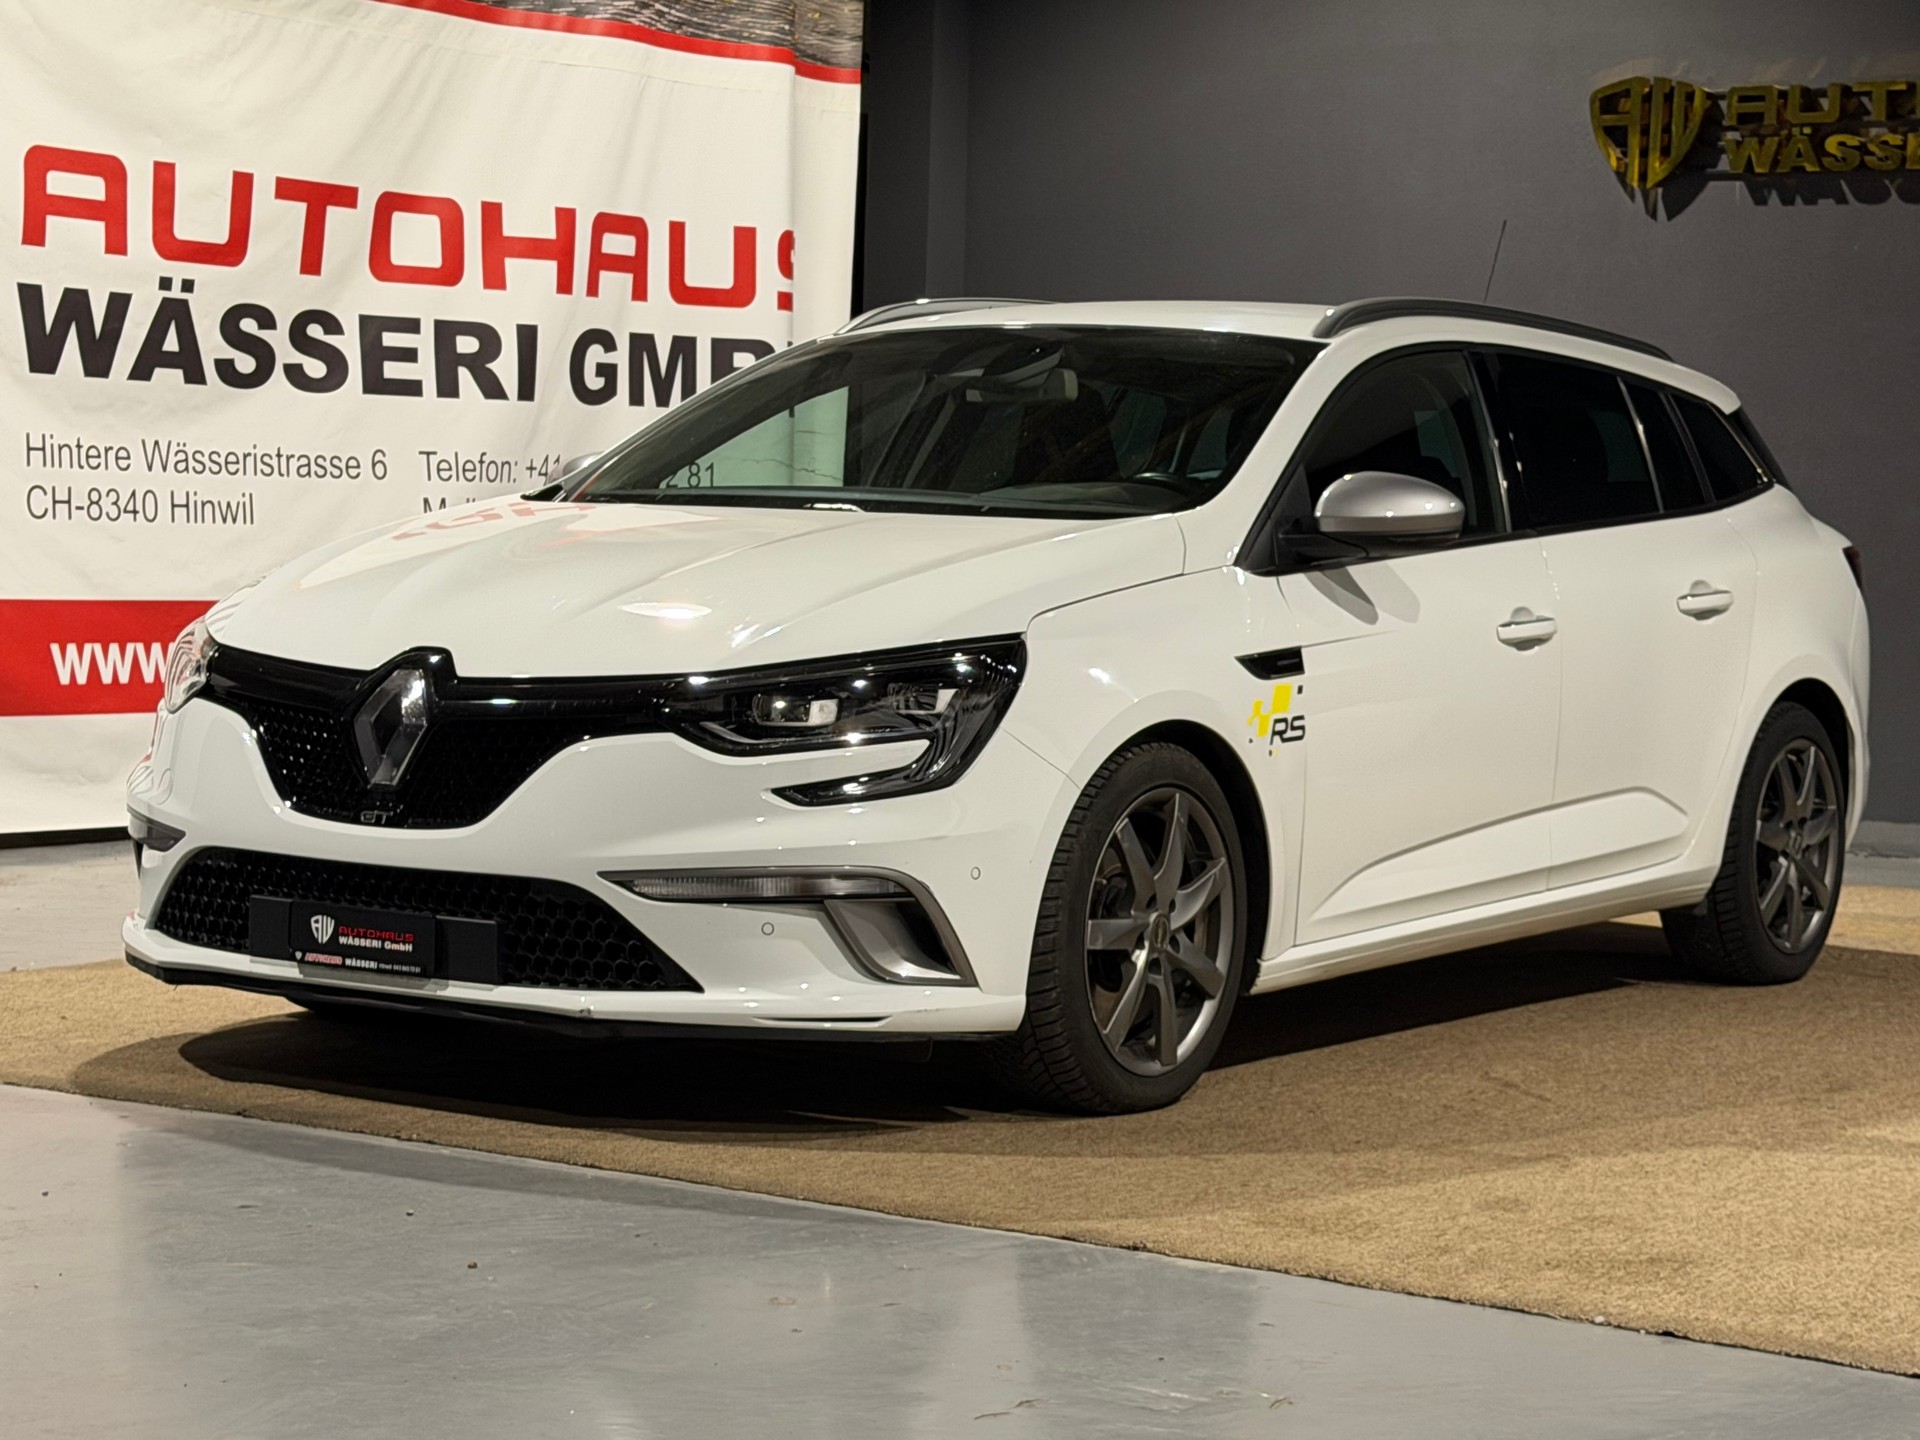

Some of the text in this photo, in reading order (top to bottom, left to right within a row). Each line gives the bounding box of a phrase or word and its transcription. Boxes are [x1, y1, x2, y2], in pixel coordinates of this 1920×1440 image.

[1726, 80, 1920, 127] AUT
[21, 144, 796, 312] AUTOHAU
[16, 275, 538, 403] WÄSSERI
[25, 432, 388, 480] Hintere Wässeristrasse 6
[418, 451, 518, 484] Telefon:
[26, 484, 255, 525] CH-8340 Hinwil
[1269, 714, 1306, 746] RS
[361, 809, 394, 825] GT
[338, 925, 414, 942] AUTOHAUS
[338, 935, 413, 952] WÄSSERI GmbH
